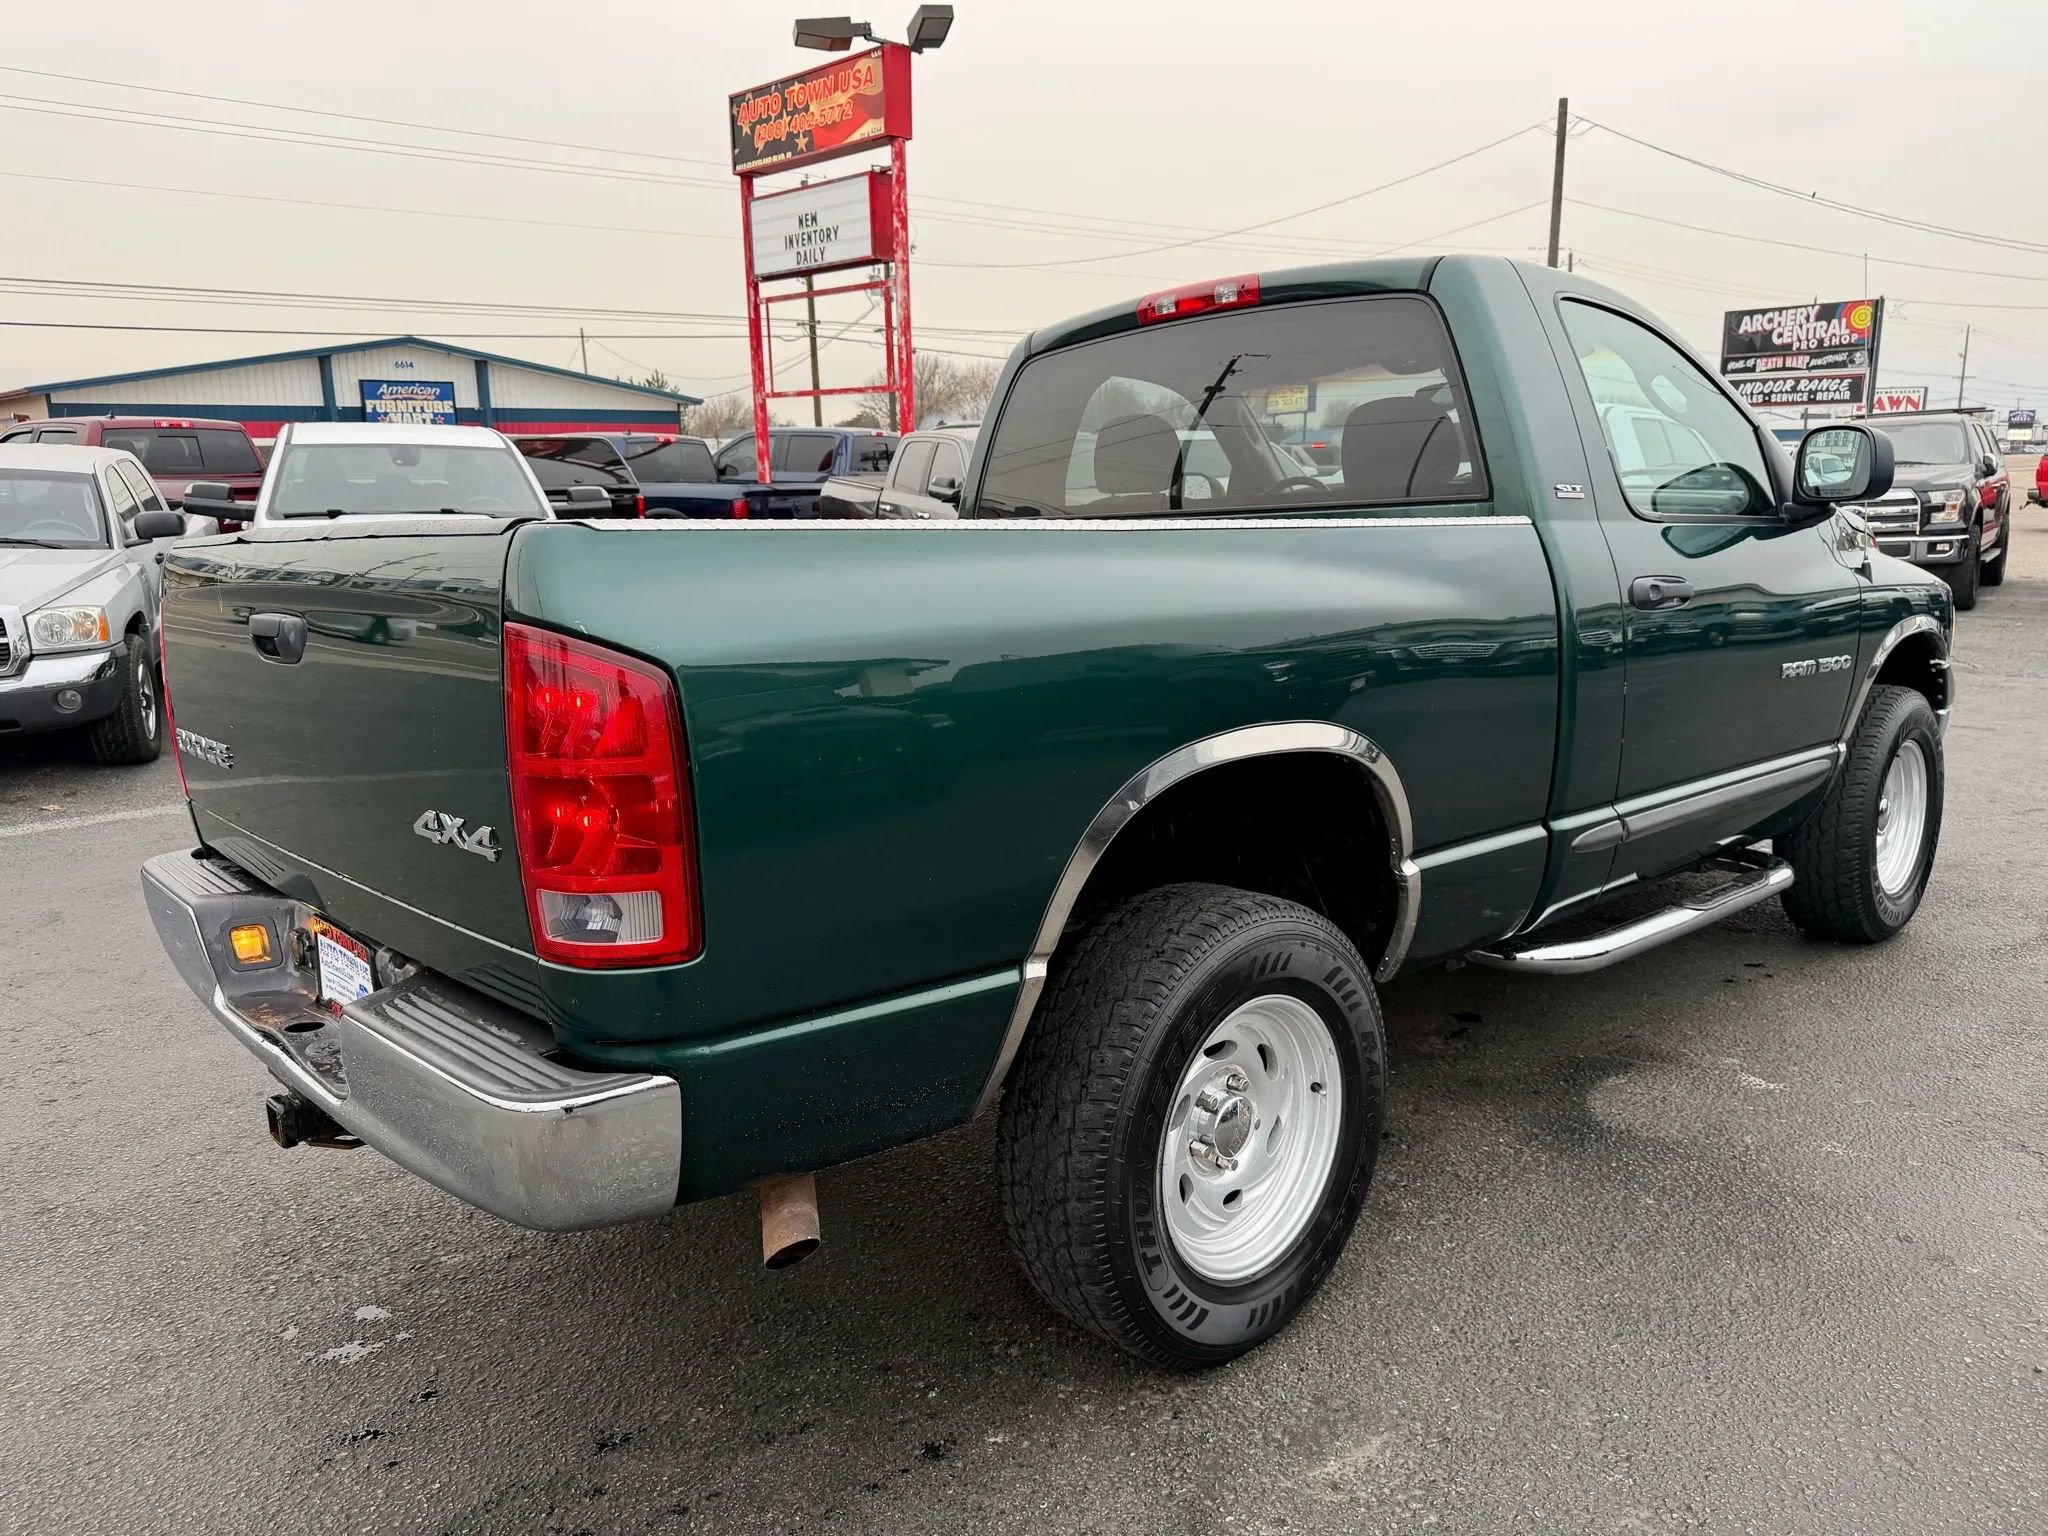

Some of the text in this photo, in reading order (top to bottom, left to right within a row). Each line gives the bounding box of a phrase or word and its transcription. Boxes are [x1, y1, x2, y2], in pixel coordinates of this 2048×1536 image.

[737, 63, 875, 126] AUTO TOWN USA
[754, 98, 855, 148] (208) 402-5772
[798, 211, 818, 230] NEW
[784, 224, 839, 251] INVENTORY
[796, 246, 826, 266] DAILY
[1738, 304, 1822, 335] ARCHERY
[1772, 316, 1851, 346] CENTRAL
[1792, 333, 1858, 352] PRO SHOP
[394, 360, 414, 369] 6614
[1756, 355, 1784, 373] DEATH
[1785, 354, 1811, 370] HARP
[376, 383, 441, 396] American
[1737, 378, 1853, 395] INDOOR RANGE
[1770, 391, 1809, 403] SERVICE
[1816, 390, 1851, 401] REPAIR
[1857, 395, 1921, 412] AWN
[365, 399, 454, 414] FURNITURE
[386, 412, 434, 425] MART
[1780, 659, 1817, 680] RAM
